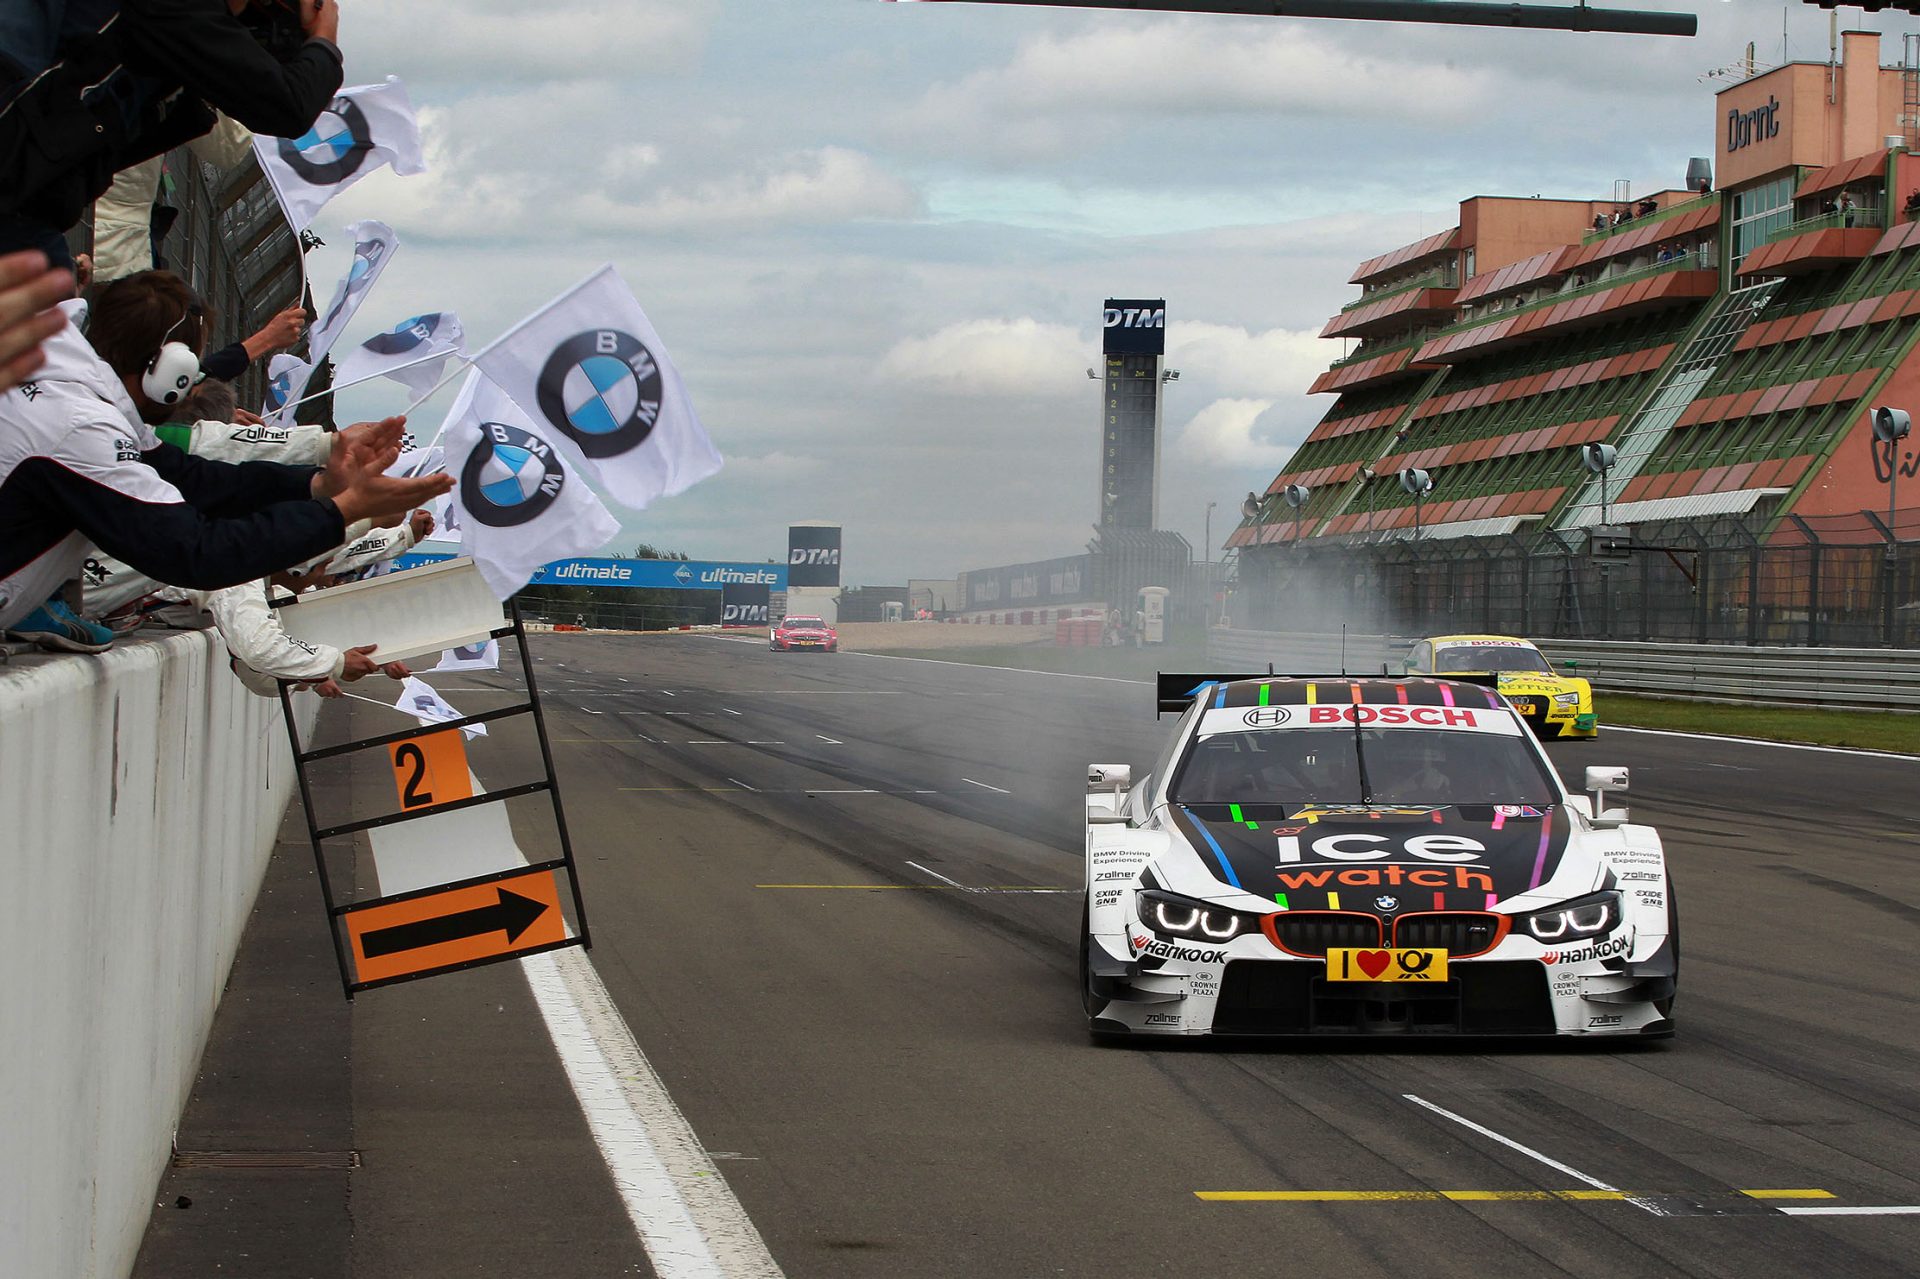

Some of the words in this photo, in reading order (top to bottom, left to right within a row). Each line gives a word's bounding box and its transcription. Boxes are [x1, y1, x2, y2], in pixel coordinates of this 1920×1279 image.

[1727, 94, 1780, 152] Dorint
[1104, 308, 1164, 328] DTM
[596, 331, 659, 427] BMW
[490, 424, 563, 497] BMW
[790, 549, 838, 565] DTM
[556, 563, 632, 580] ultimate
[701, 568, 777, 585] ultimate
[723, 604, 768, 621] DTM
[1309, 706, 1478, 727] BOSCH
[395, 742, 433, 809] 2
[1119, 850, 1151, 858] Driving
[1629, 851, 1661, 859] Driving
[1612, 857, 1661, 865] Experience
[1277, 865, 1493, 891] watch
[1095, 890, 1123, 898] EXIDE
[1634, 890, 1663, 898] EXIDE
[1095, 898, 1117, 906] GNB
[1641, 897, 1663, 906] GNB
[1189, 981, 1219, 989] CROWNE
[1552, 980, 1580, 990] CROWNE
[1192, 988, 1215, 996] PLAZA
[1556, 988, 1577, 996] PLAZA
